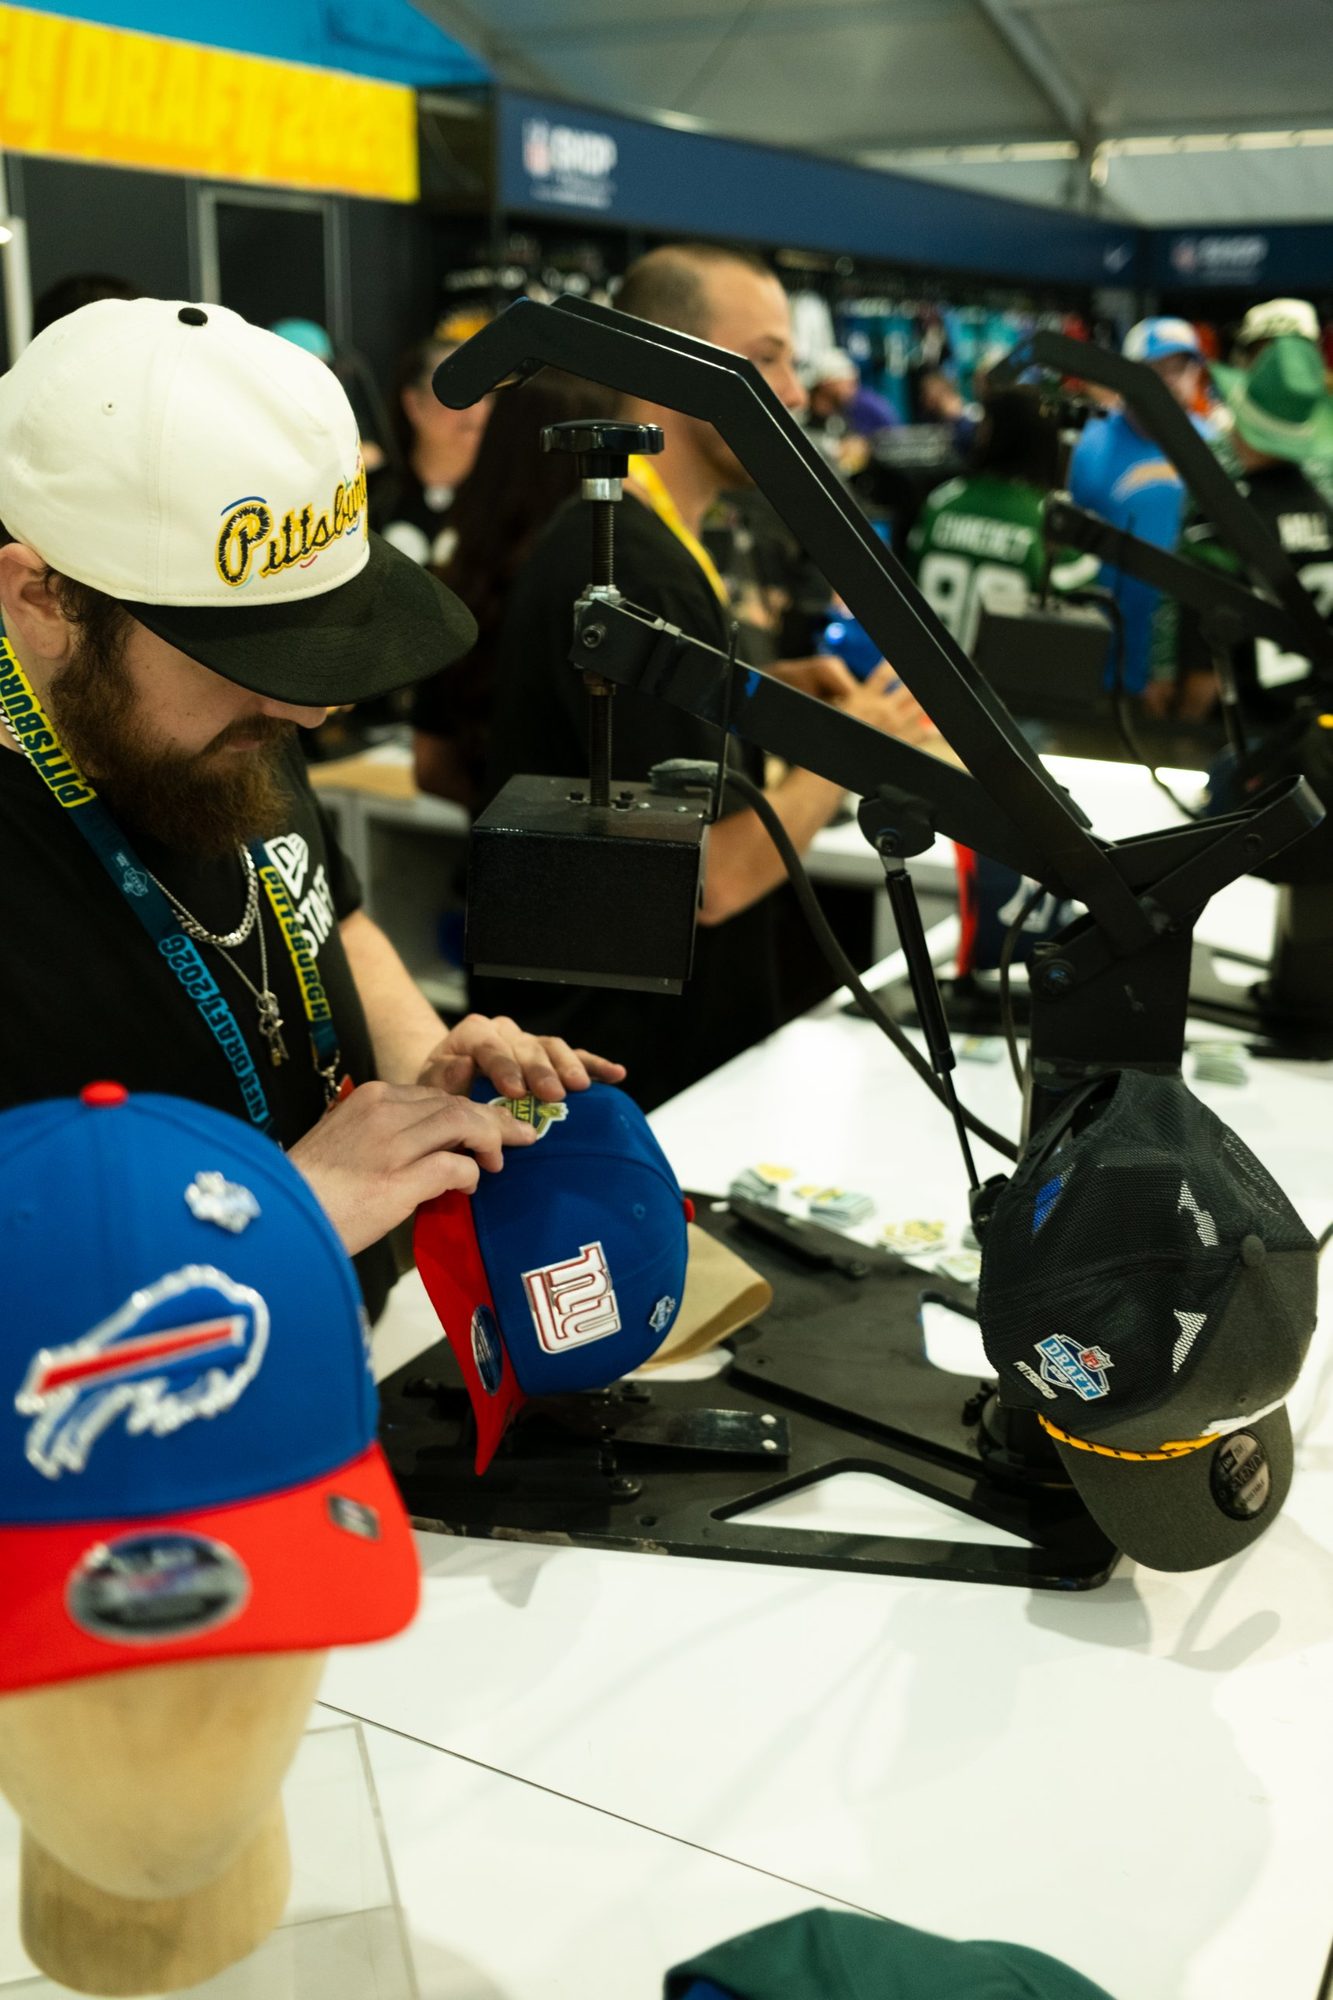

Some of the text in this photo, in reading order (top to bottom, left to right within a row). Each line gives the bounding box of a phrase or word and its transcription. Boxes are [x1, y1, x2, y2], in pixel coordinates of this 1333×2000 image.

[263, 870, 331, 1022] PITTSBURGH
[159, 935, 269, 1123] NFL DRAFT 2026
[1044, 1341, 1099, 1398] DRAFT
